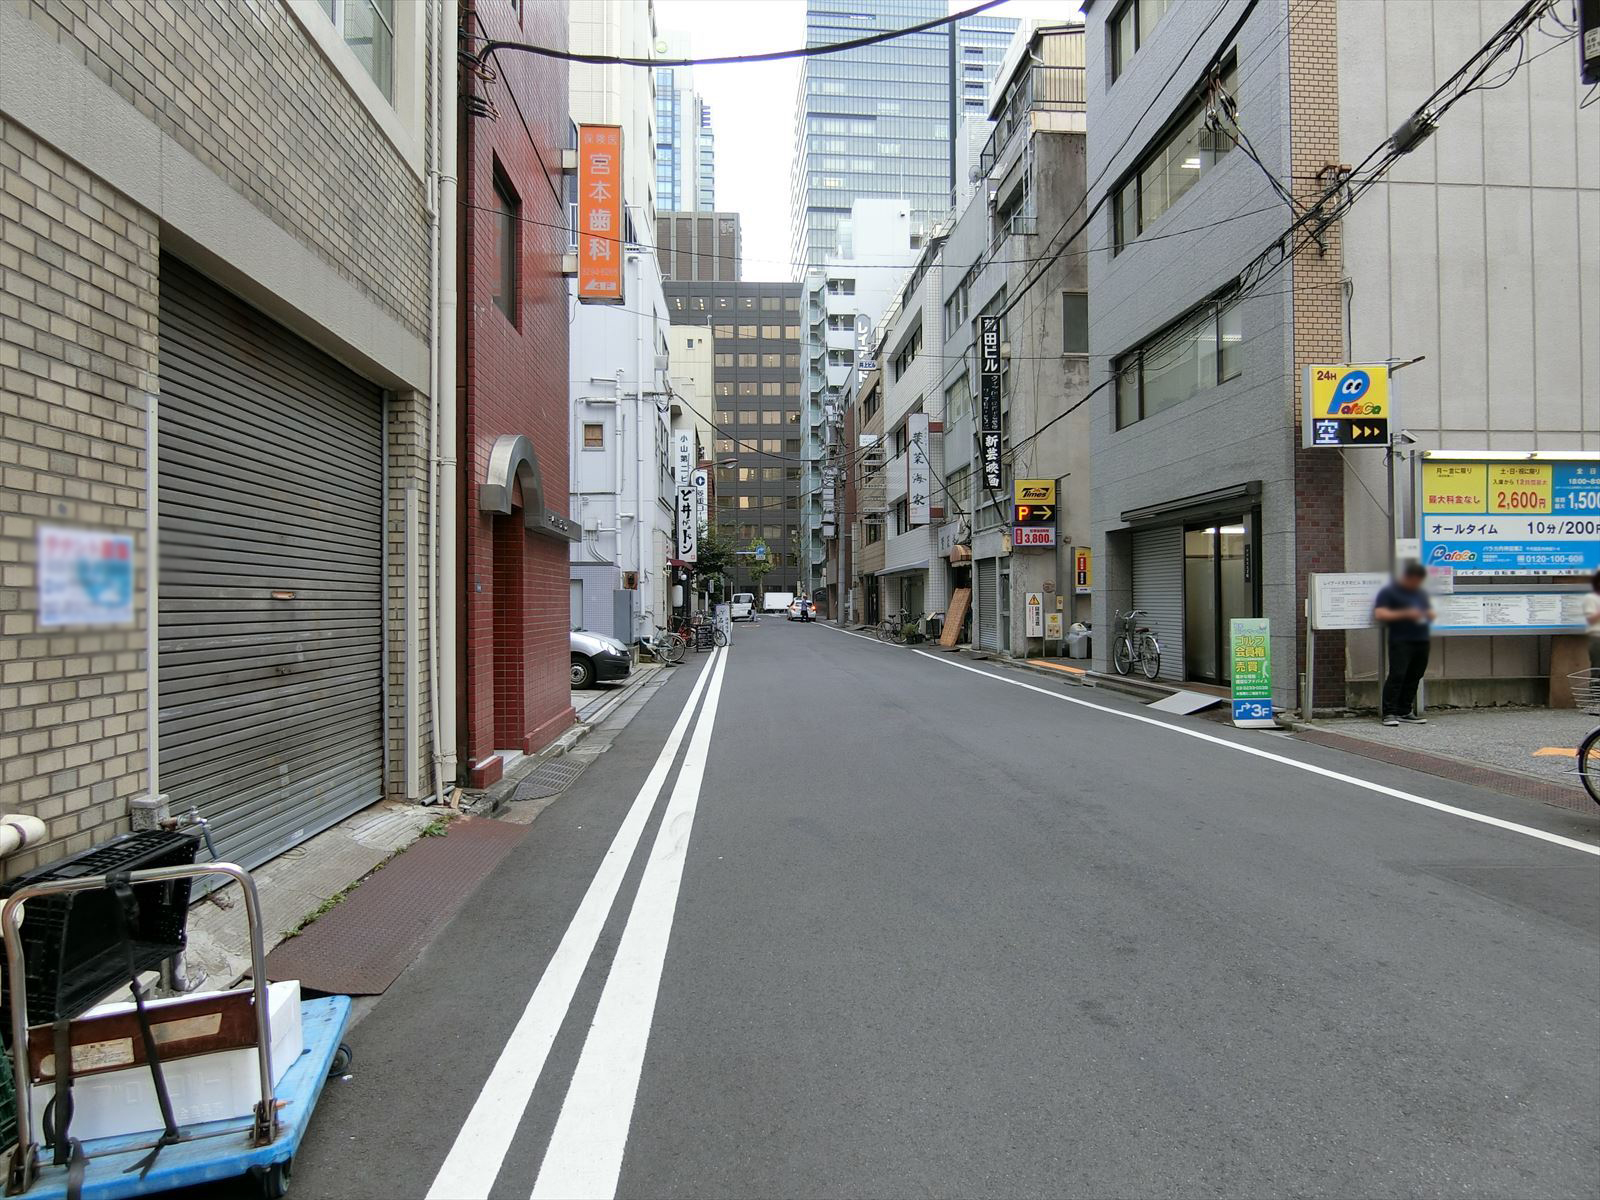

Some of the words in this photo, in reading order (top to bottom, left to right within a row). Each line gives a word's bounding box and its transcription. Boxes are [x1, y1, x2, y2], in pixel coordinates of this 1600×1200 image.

[589, 153, 612, 261] 宮本歯科
[1316, 370, 1337, 381] 24H
[1315, 420, 1339, 444] 空
[1021, 488, 1050, 498] Times
[1428, 495, 1480, 504] 最大料金なし
[1497, 491, 1546, 509] 2,600円
[1432, 523, 1498, 535] オールタイム
[1235, 635, 1265, 646] ゴルフ
[1251, 703, 1270, 717] 3F
